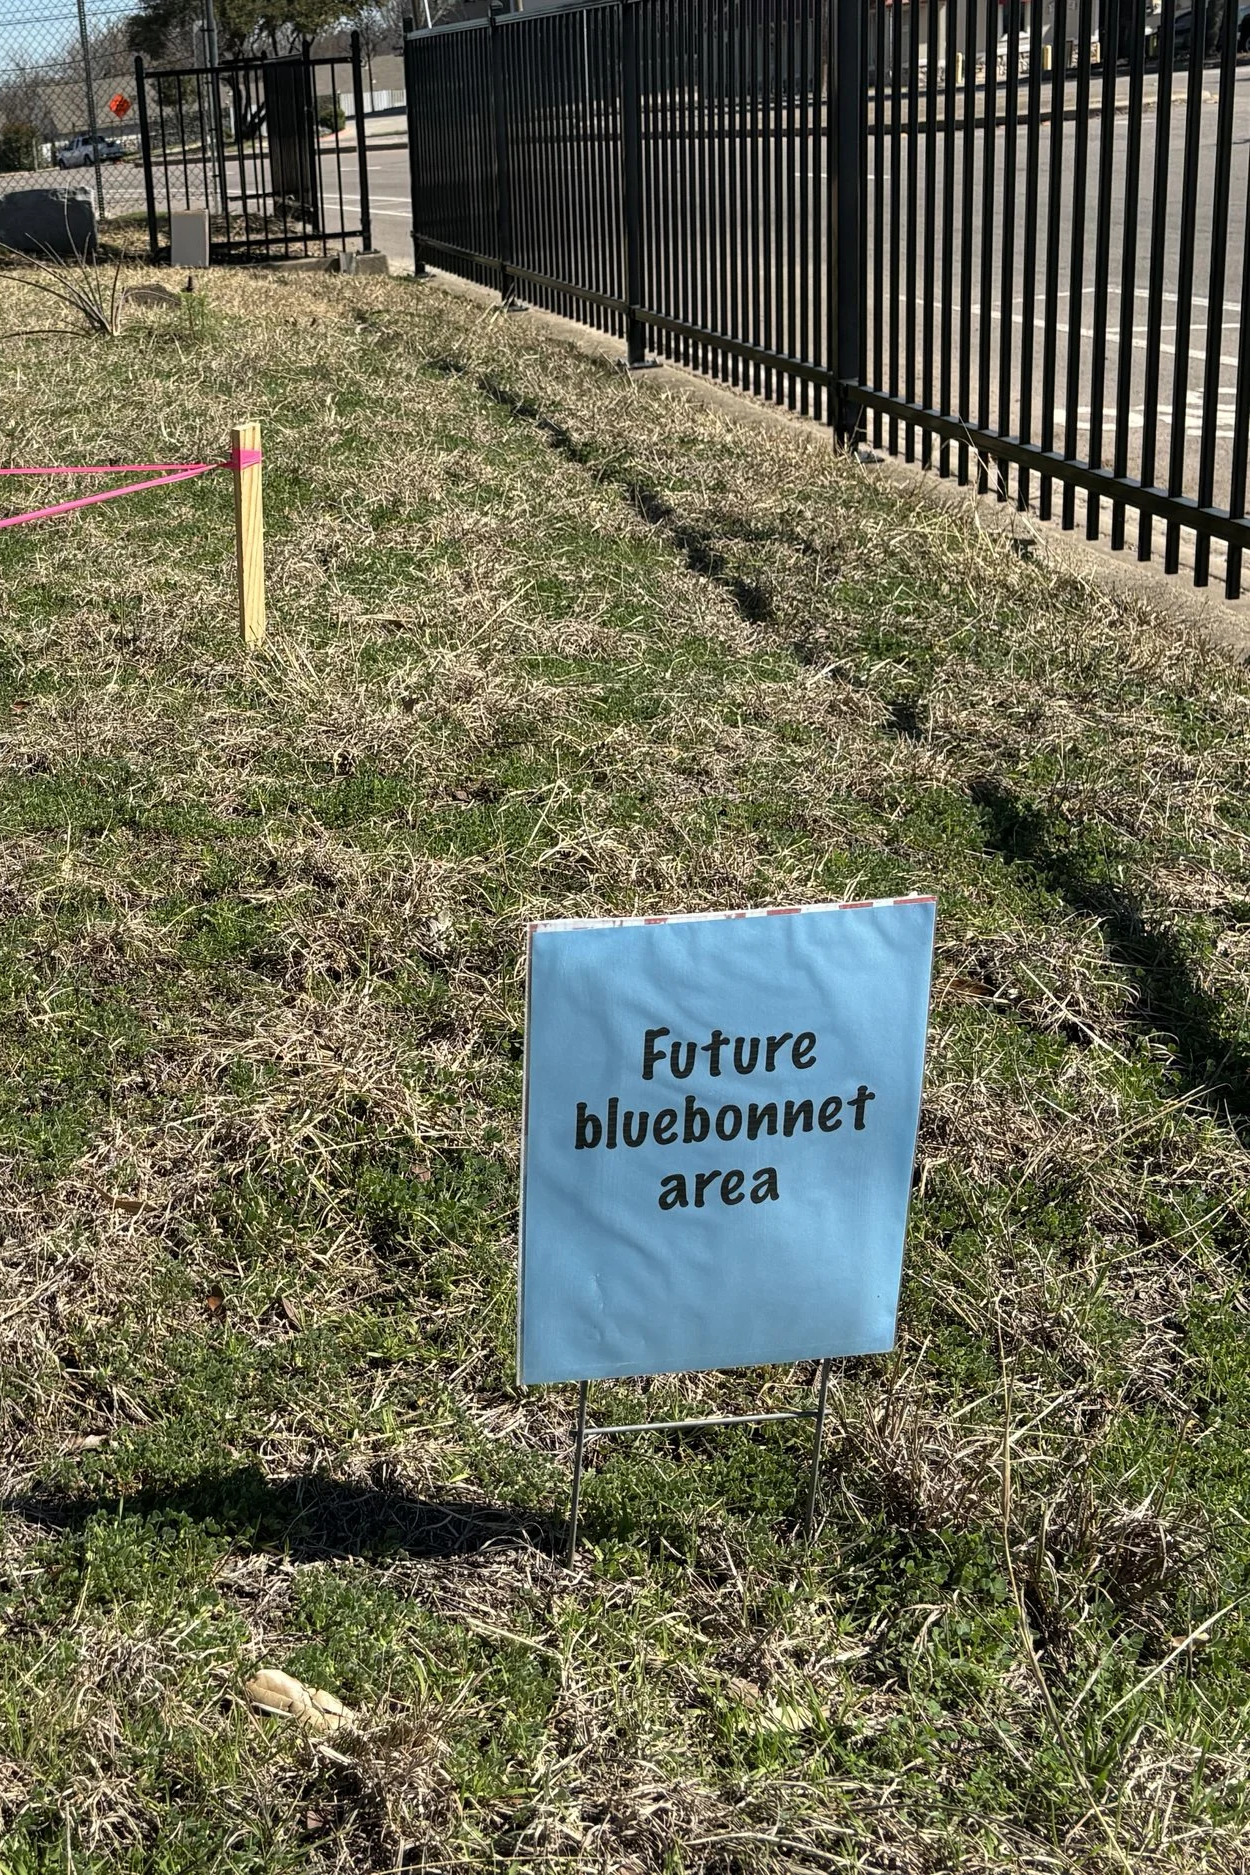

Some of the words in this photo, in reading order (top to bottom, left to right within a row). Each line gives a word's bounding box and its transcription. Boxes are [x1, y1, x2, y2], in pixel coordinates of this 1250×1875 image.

[641, 1026, 818, 1081] Future
[574, 1085, 876, 1151] bluebonnet
[657, 1166, 780, 1211] area
